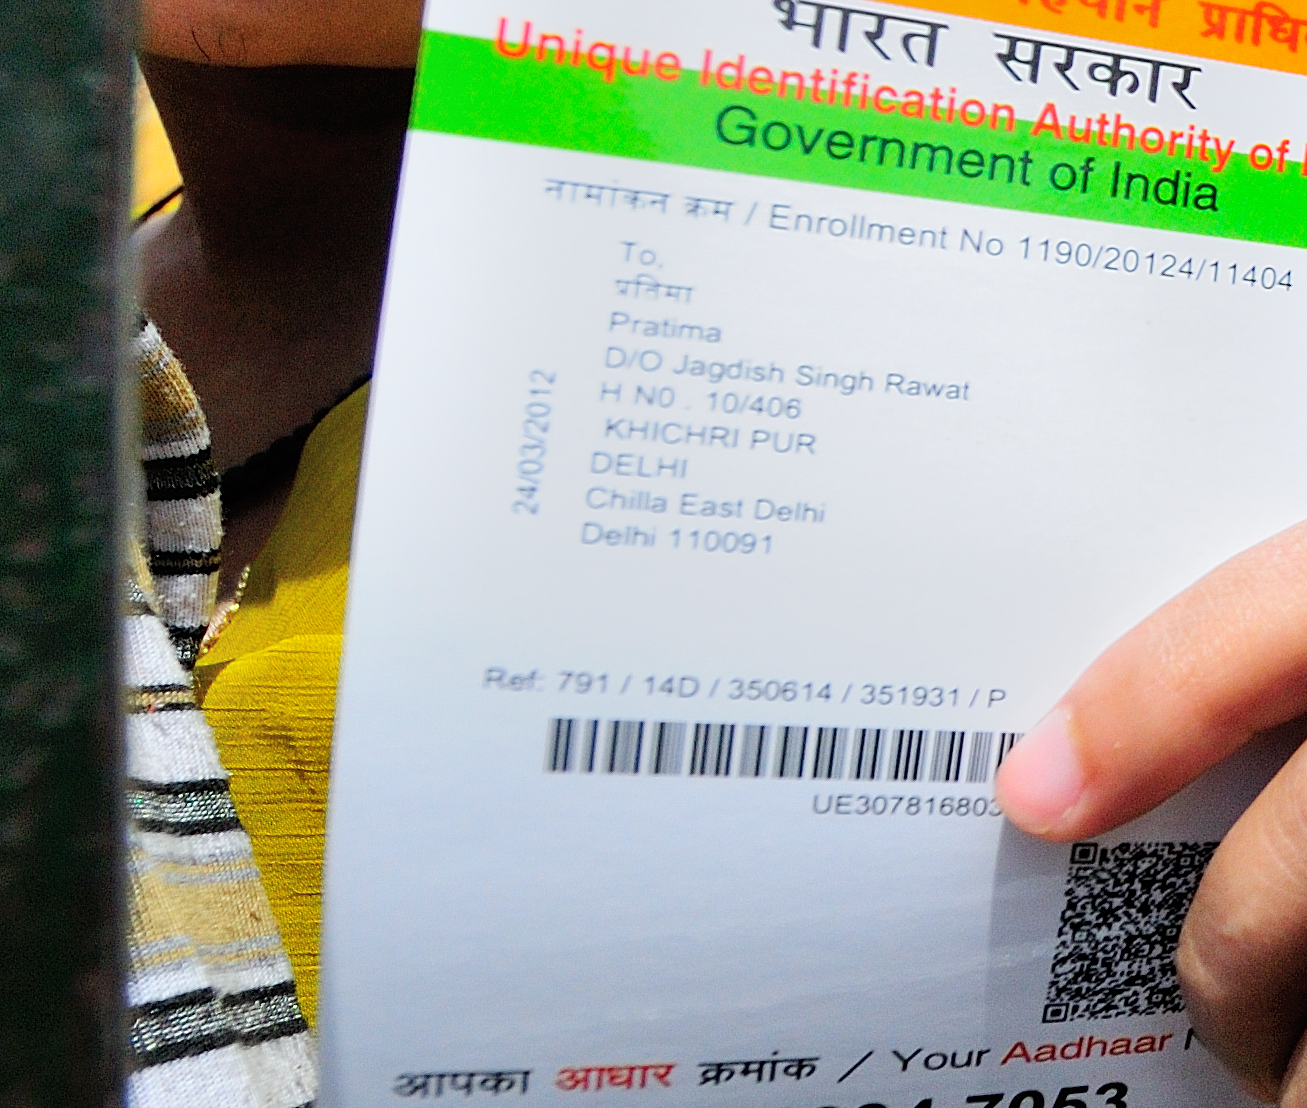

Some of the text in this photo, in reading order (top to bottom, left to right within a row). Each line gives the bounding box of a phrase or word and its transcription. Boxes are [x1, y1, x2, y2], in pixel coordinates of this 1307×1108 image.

[994, 32, 1202, 110] सरकार
[495, 18, 683, 83] Unique
[699, 49, 1016, 133] Identification
[1030, 102, 1235, 173] Authority
[1249, 139, 1291, 173] of
[716, 105, 1219, 212] Government of India
[769, 203, 949, 250] Enrollment
[960, 228, 1004, 257] No
[1020, 236, 1295, 291] 1190/20124/11404
[608, 311, 722, 344] Pratima
[605, 346, 971, 401] D/O Jagdish Singh Rawat
[600, 381, 622, 404] H
[706, 391, 802, 420] 10/406
[511, 368, 558, 516] 24/03/2012
[603, 418, 817, 455] KHICHRI PUR
[590, 452, 688, 479] DELHI
[585, 486, 827, 524] Chilla East Delhi
[580, 522, 773, 555] Delhi 110091
[557, 672, 609, 695] 791
[643, 676, 701, 698] 14D
[729, 678, 833, 704] 350614
[860, 684, 961, 708] 351931
[987, 689, 1008, 708] P
[393, 1068, 533, 1099] आपका
[554, 1061, 678, 1092] आधार
[892, 1048, 991, 1073] Your
[1000, 1033, 1175, 1066] Aadhaar
